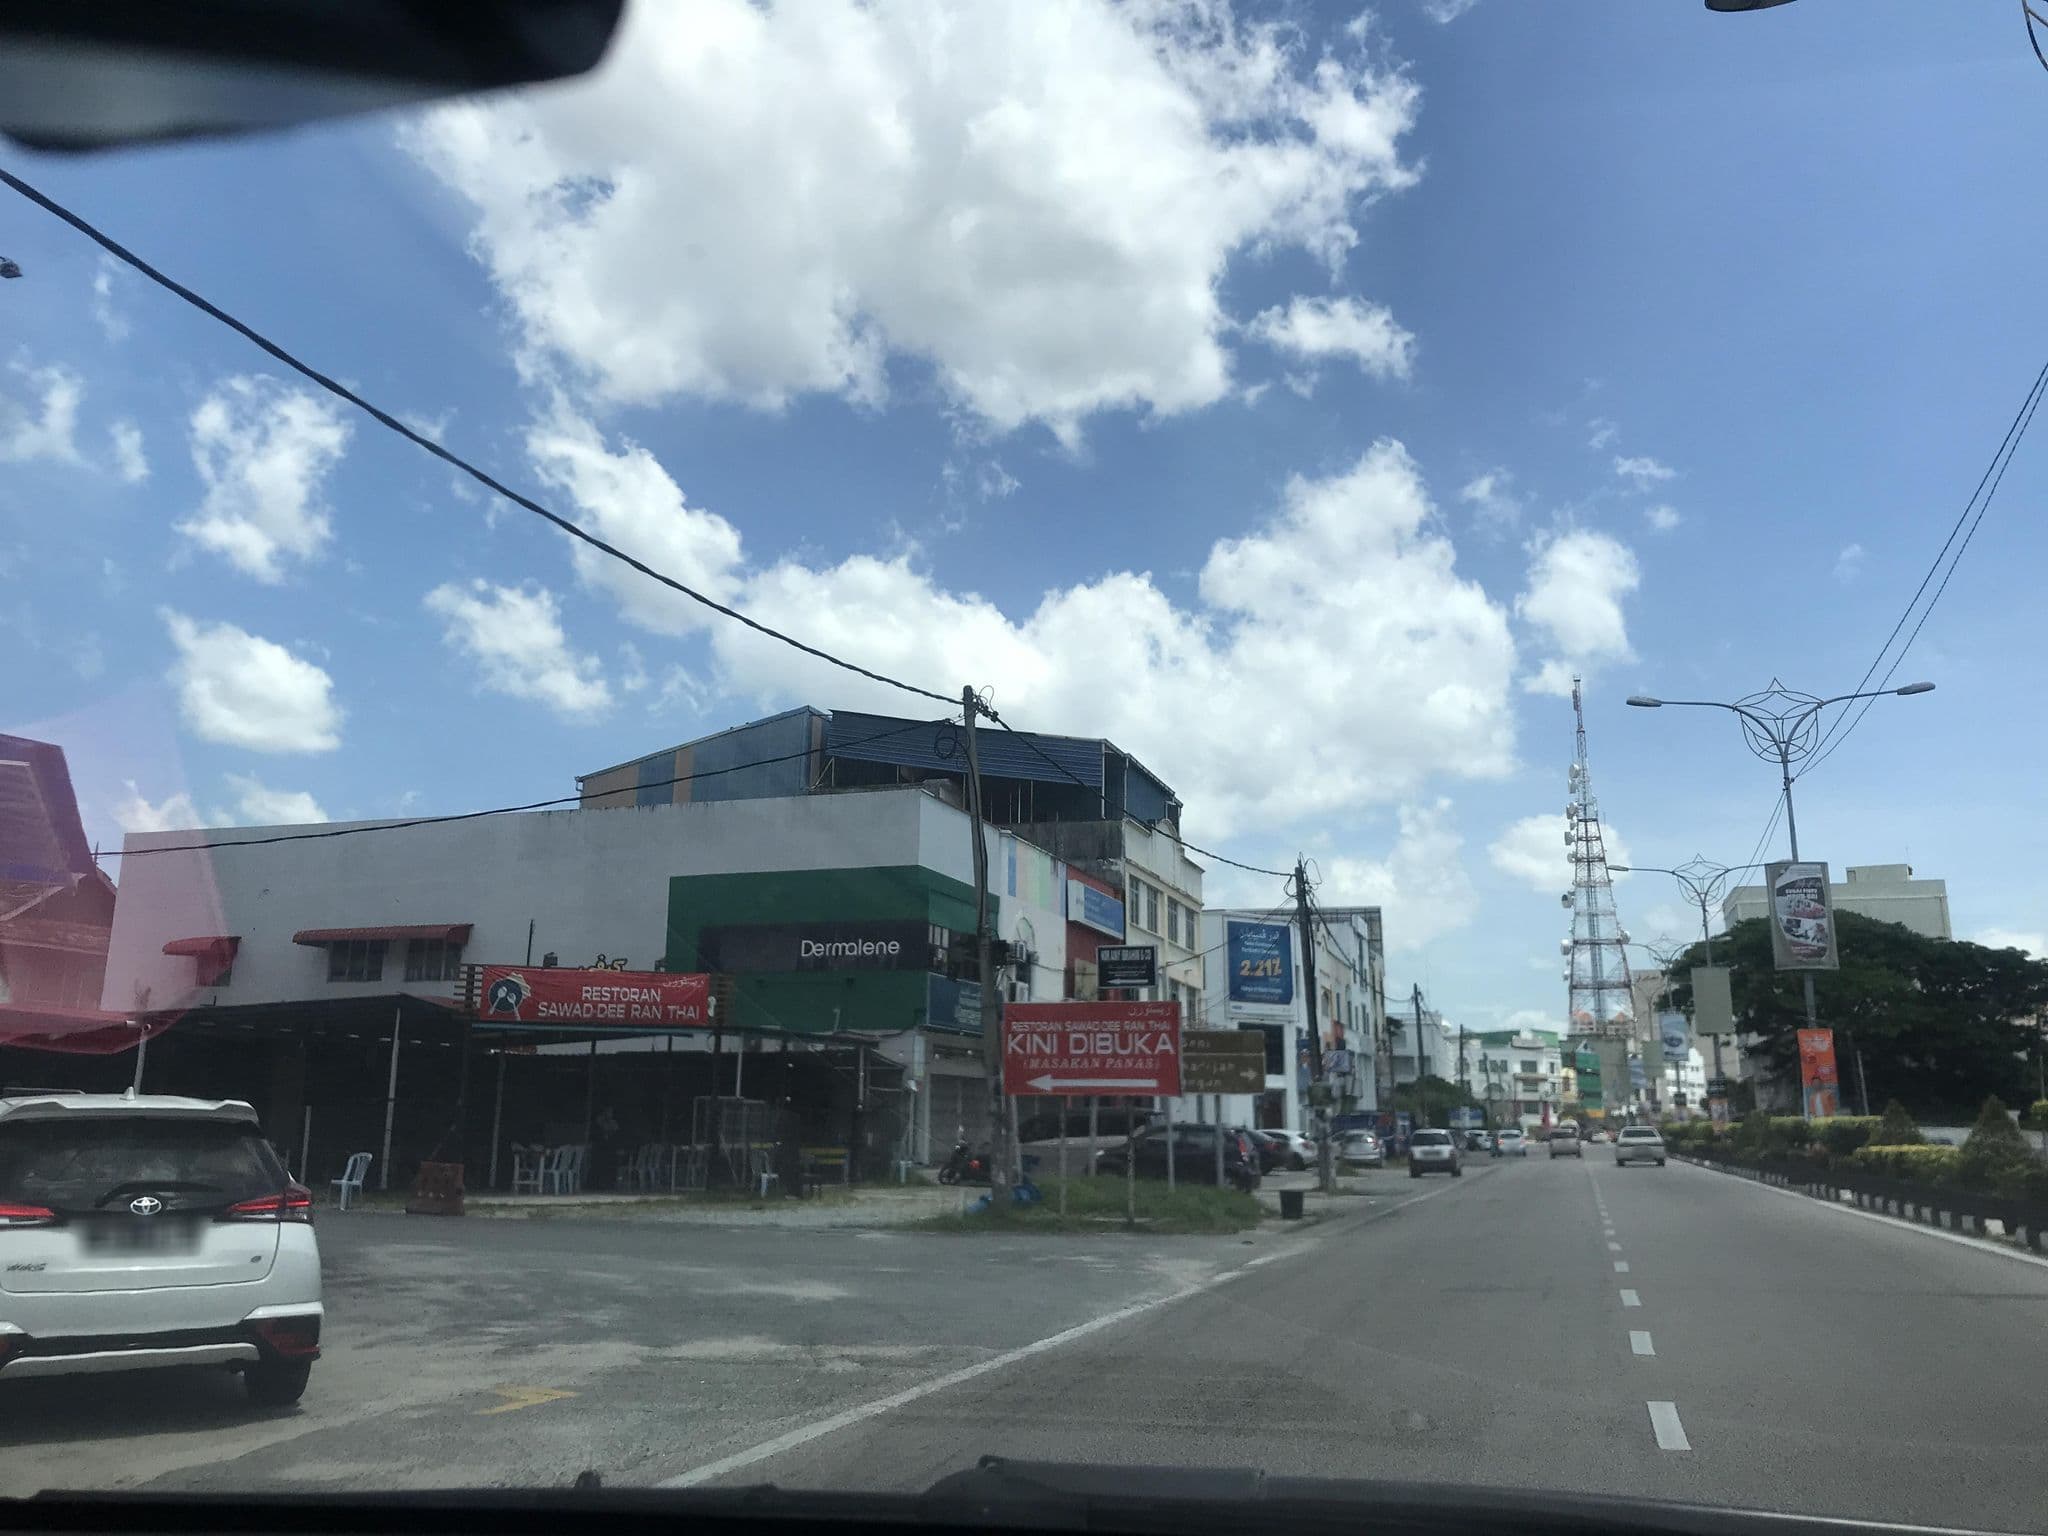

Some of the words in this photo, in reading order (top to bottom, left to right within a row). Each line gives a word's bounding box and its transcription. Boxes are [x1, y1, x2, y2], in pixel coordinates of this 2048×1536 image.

[801, 939, 900, 957] Dermalene
[582, 986, 661, 1002] RESTORAN
[631, 1004, 662, 1019] RAN
[667, 1006, 699, 1019] THAI
[1011, 1021, 1062, 1031] RESTORAN
[1124, 1021, 1145, 1031] RAN
[1008, 1034, 1058, 1054] KINI
[1069, 1033, 1176, 1054] DIBUKA
